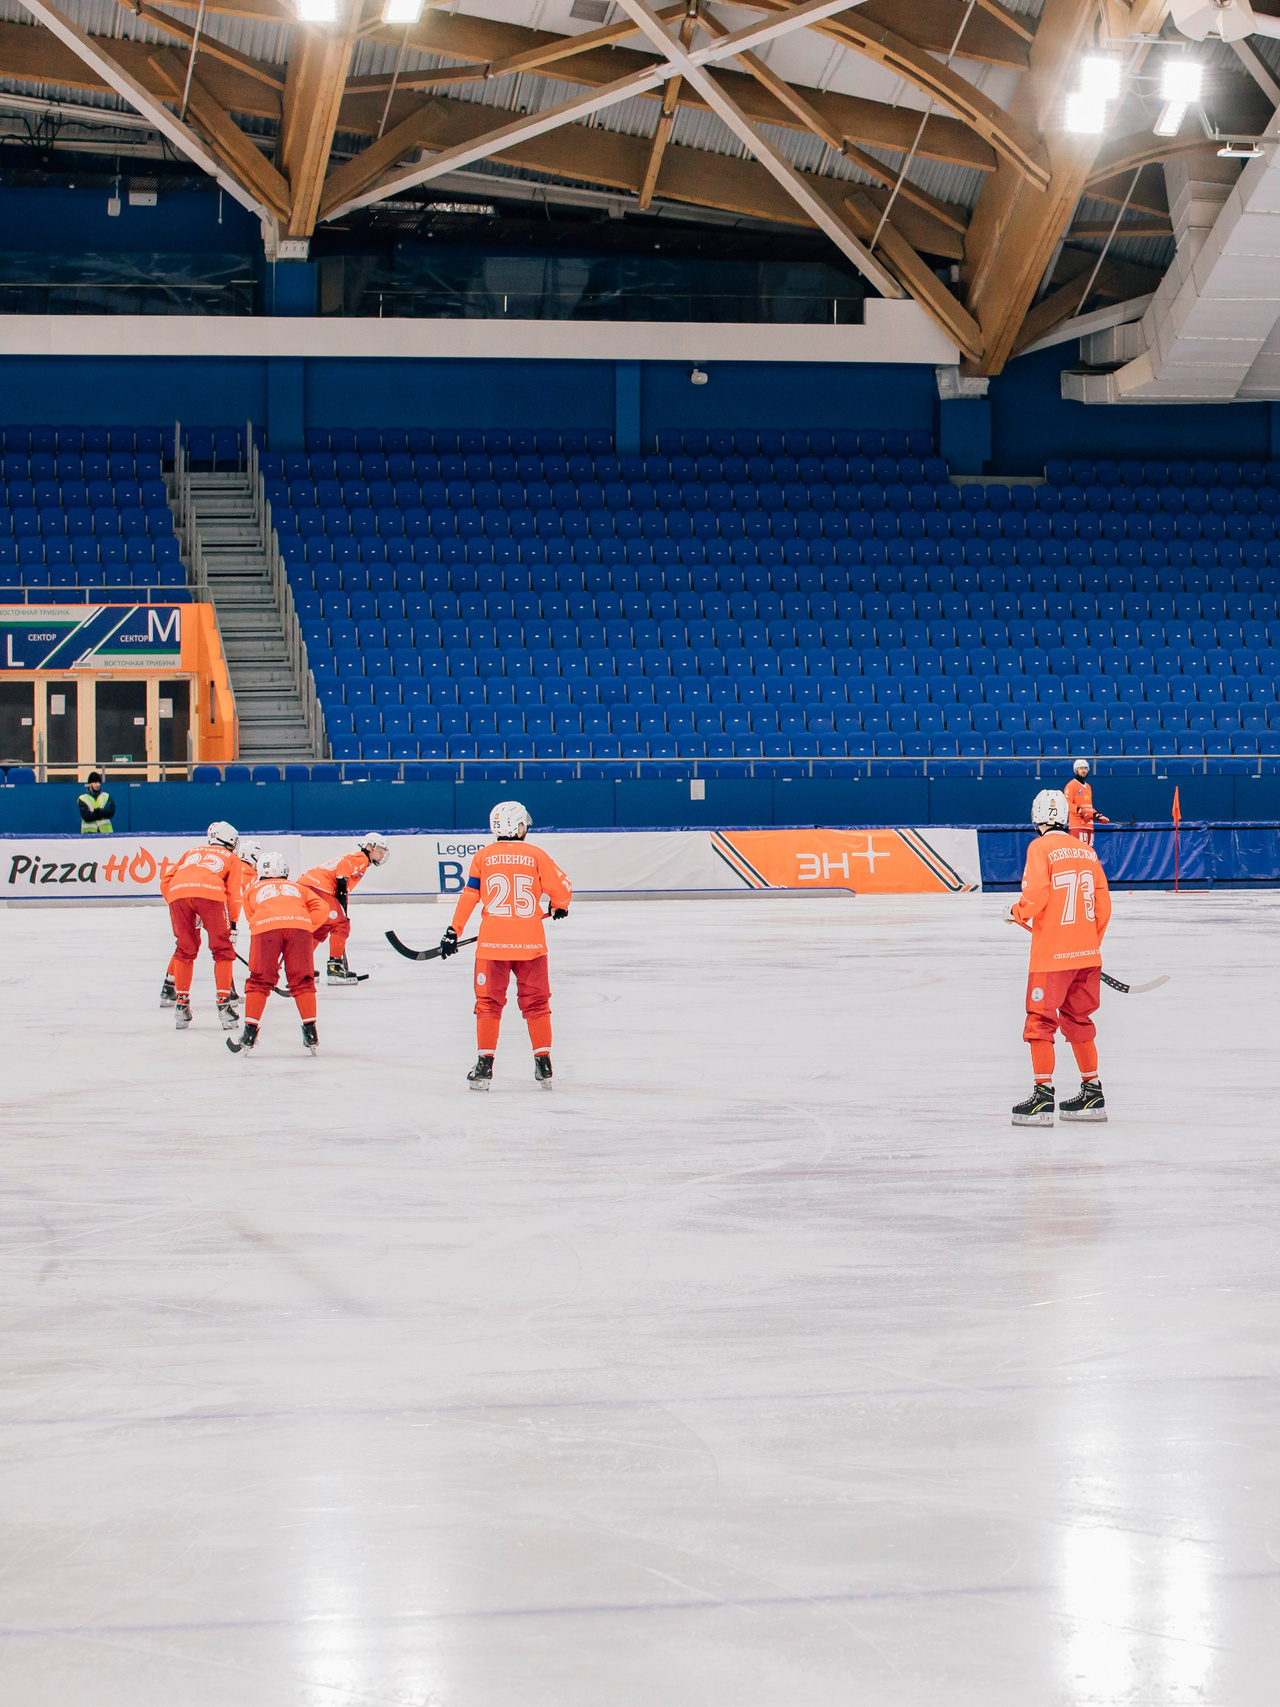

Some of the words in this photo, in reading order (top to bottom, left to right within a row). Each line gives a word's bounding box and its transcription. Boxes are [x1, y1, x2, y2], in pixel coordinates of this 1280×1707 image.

[27, 633, 57, 642] СЕКТОР
[120, 634, 149, 643] СЕКТОР
[7, 634, 25, 667] L
[104, 660, 144, 668] ВОСТОЧНАЯ
[146, 660, 176, 668] ТРИБУНА
[1048, 808, 1058, 817] 73
[485, 854, 535, 868] ЗЕЛЕНИН
[8, 855, 99, 884] Pizza
[485, 873, 537, 918] 25
[1051, 870, 1096, 926] 73
